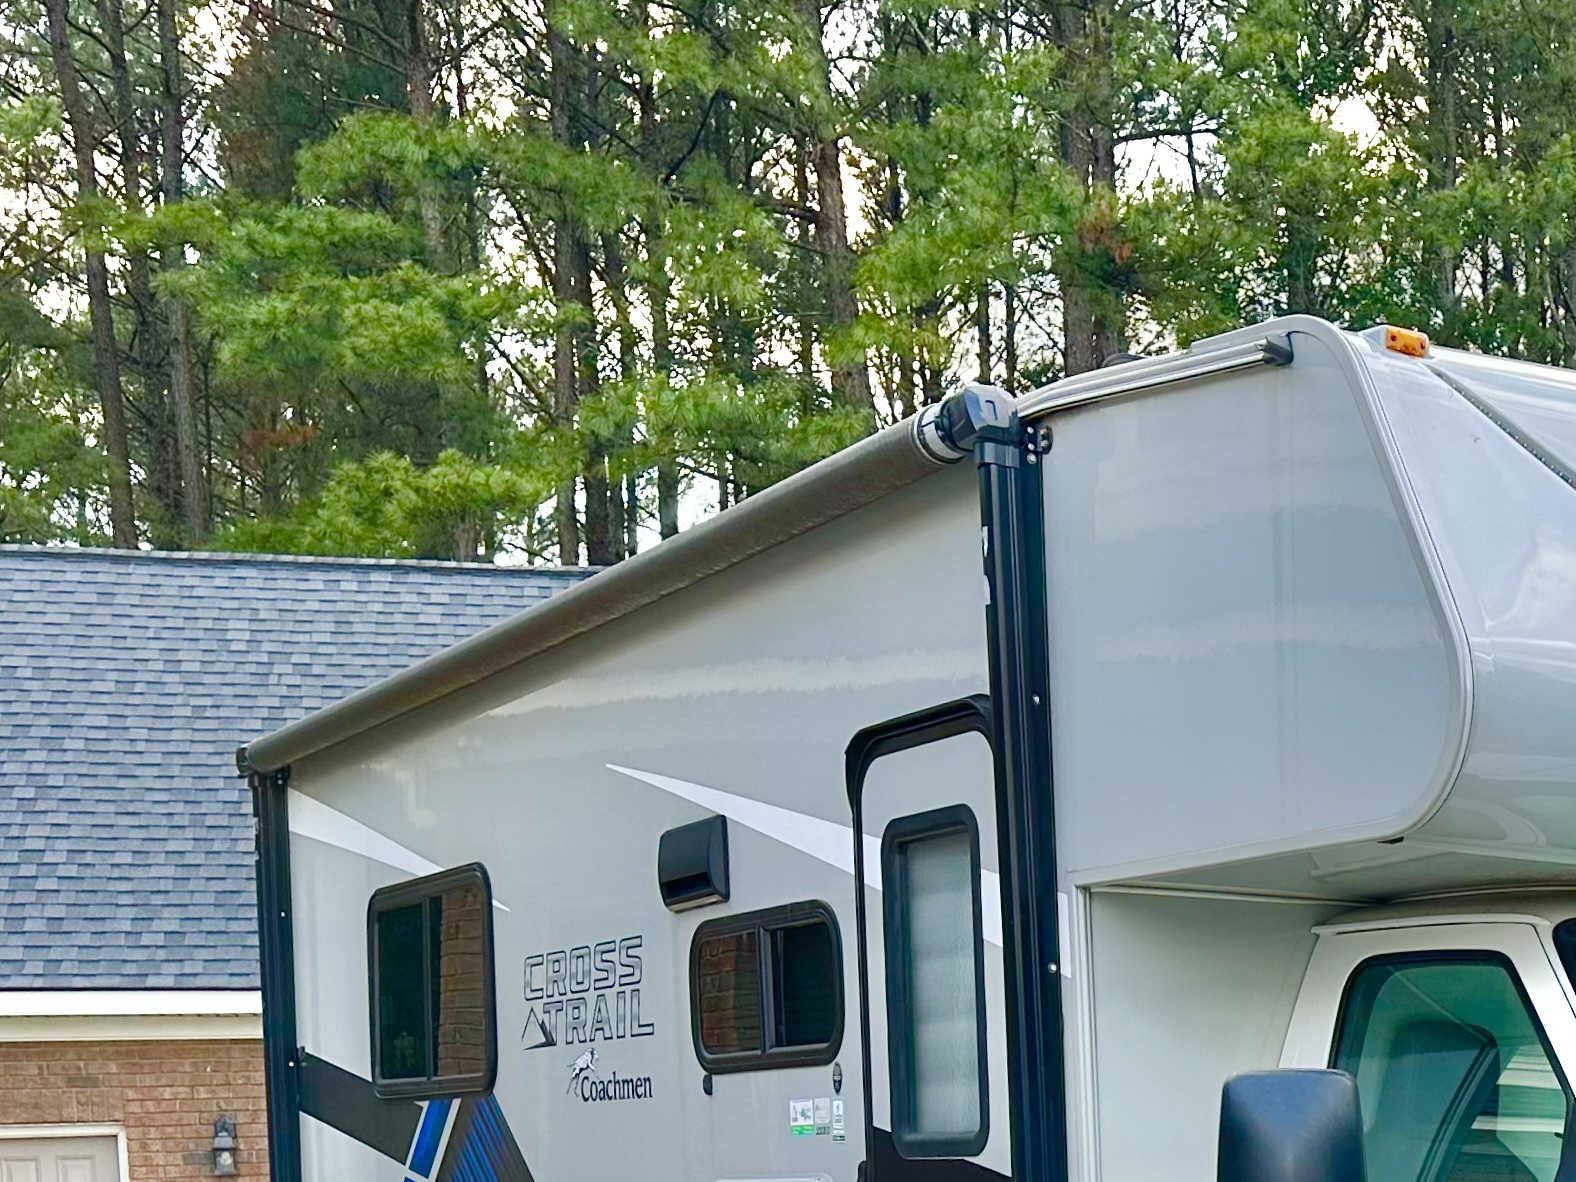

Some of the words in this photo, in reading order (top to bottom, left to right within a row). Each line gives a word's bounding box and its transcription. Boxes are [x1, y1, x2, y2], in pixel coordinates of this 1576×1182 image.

[523, 935, 643, 1001] CROSS
[542, 988, 655, 1046] TRAIL
[580, 1071, 653, 1103] Coachmen
